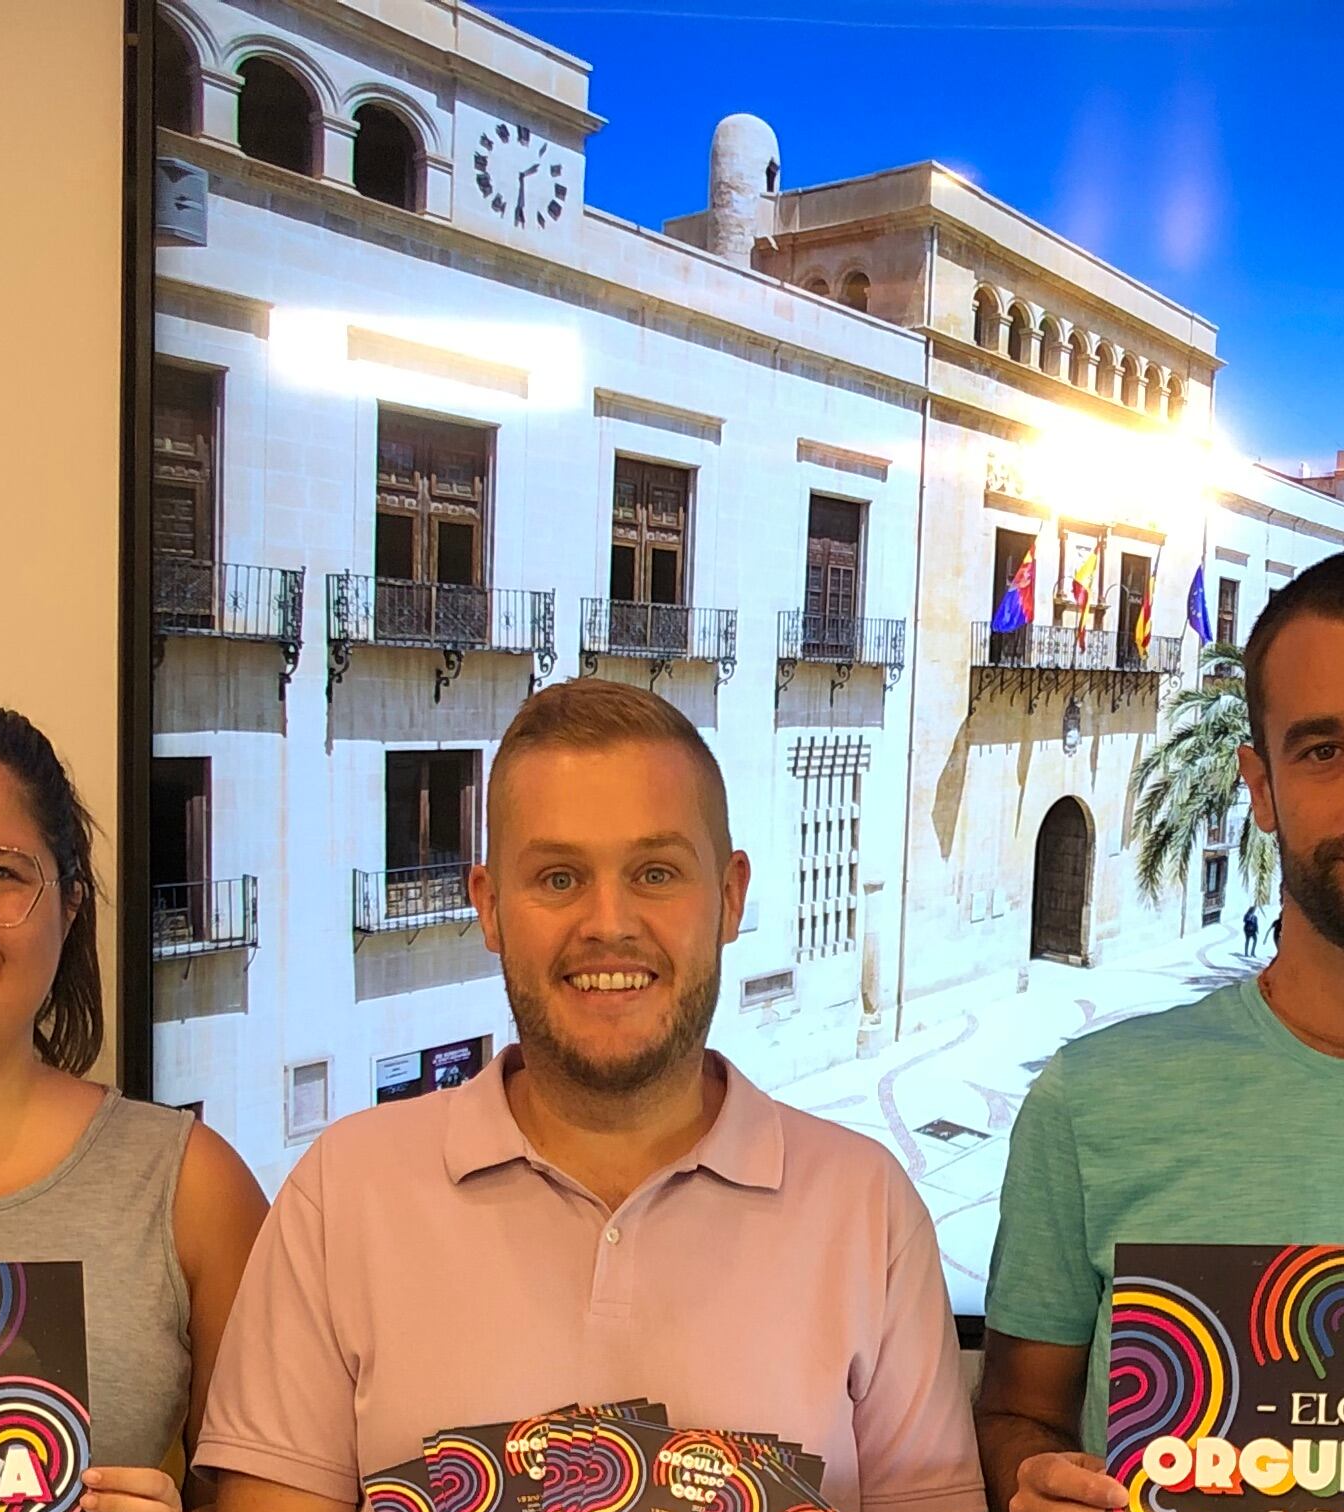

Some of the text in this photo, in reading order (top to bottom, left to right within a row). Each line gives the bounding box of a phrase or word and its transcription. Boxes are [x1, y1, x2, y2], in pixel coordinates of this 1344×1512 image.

[659, 1451, 735, 1477] ORGULLO
[682, 1471, 724, 1488] A TODO
[671, 1483, 716, 1503] COLO
